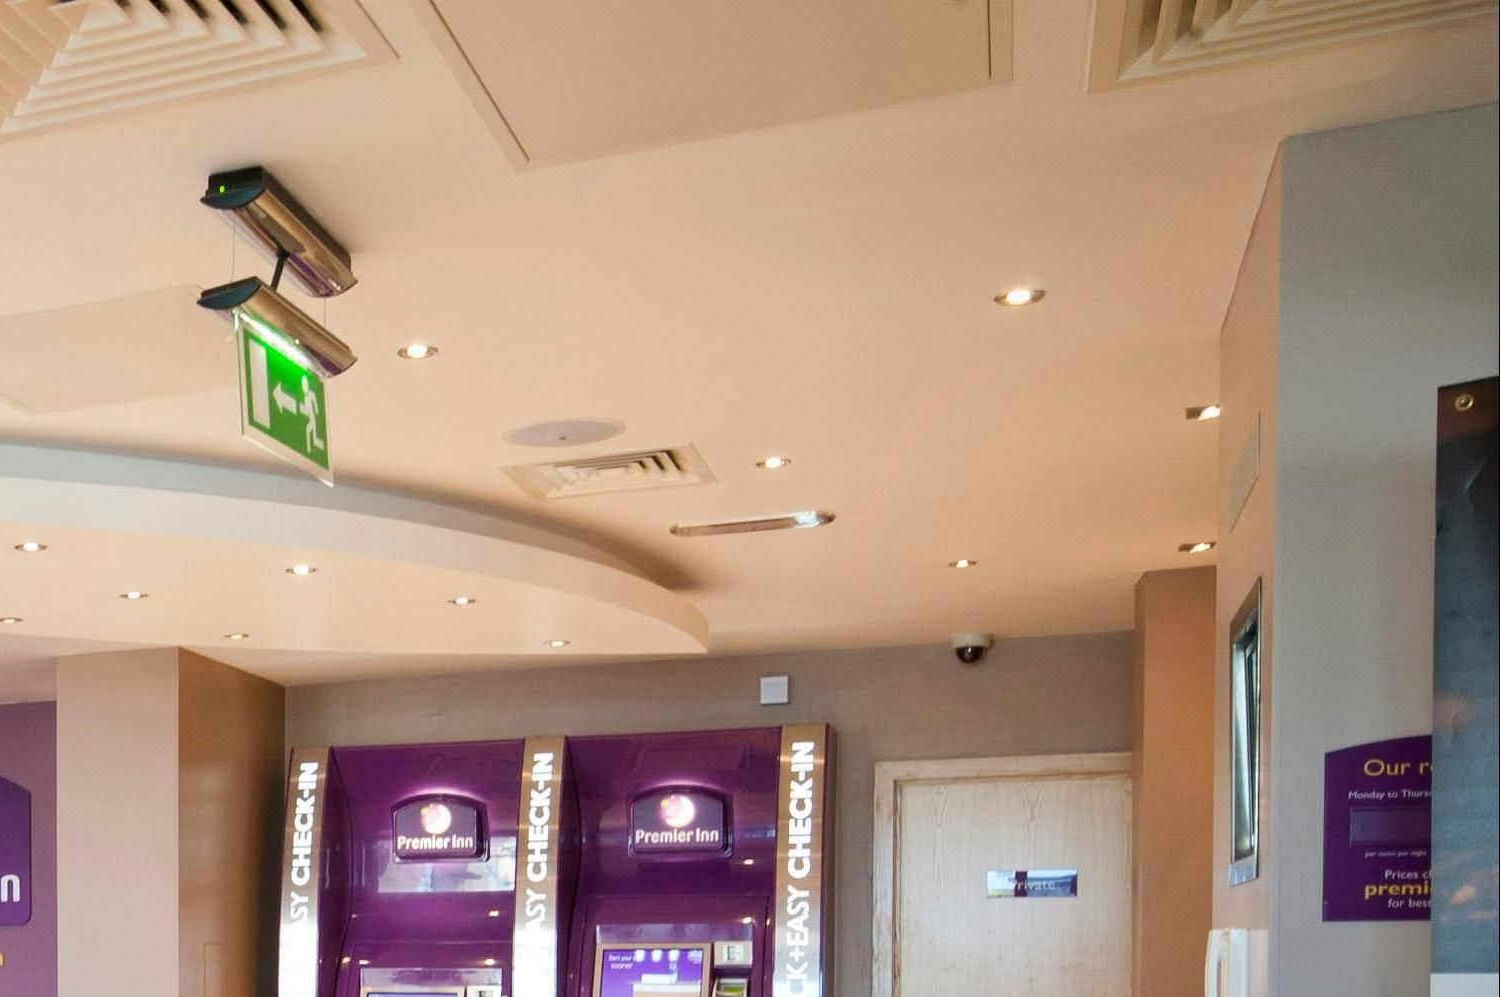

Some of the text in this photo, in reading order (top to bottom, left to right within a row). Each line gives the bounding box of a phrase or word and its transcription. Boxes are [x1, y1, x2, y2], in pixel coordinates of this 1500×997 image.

[1363, 759, 1410, 776] Our
[1348, 790, 1385, 800] Monday
[526, 752, 554, 883] CHECK-IN
[787, 741, 815, 879] CHECK-IN
[291, 762, 319, 886] CHECK-IN
[397, 834, 473, 850] Premier Inn
[635, 827, 719, 844] Premier Inn
[1384, 869, 1418, 880] Prices
[1364, 880, 1432, 900] premi
[1387, 898, 1405, 908] for
